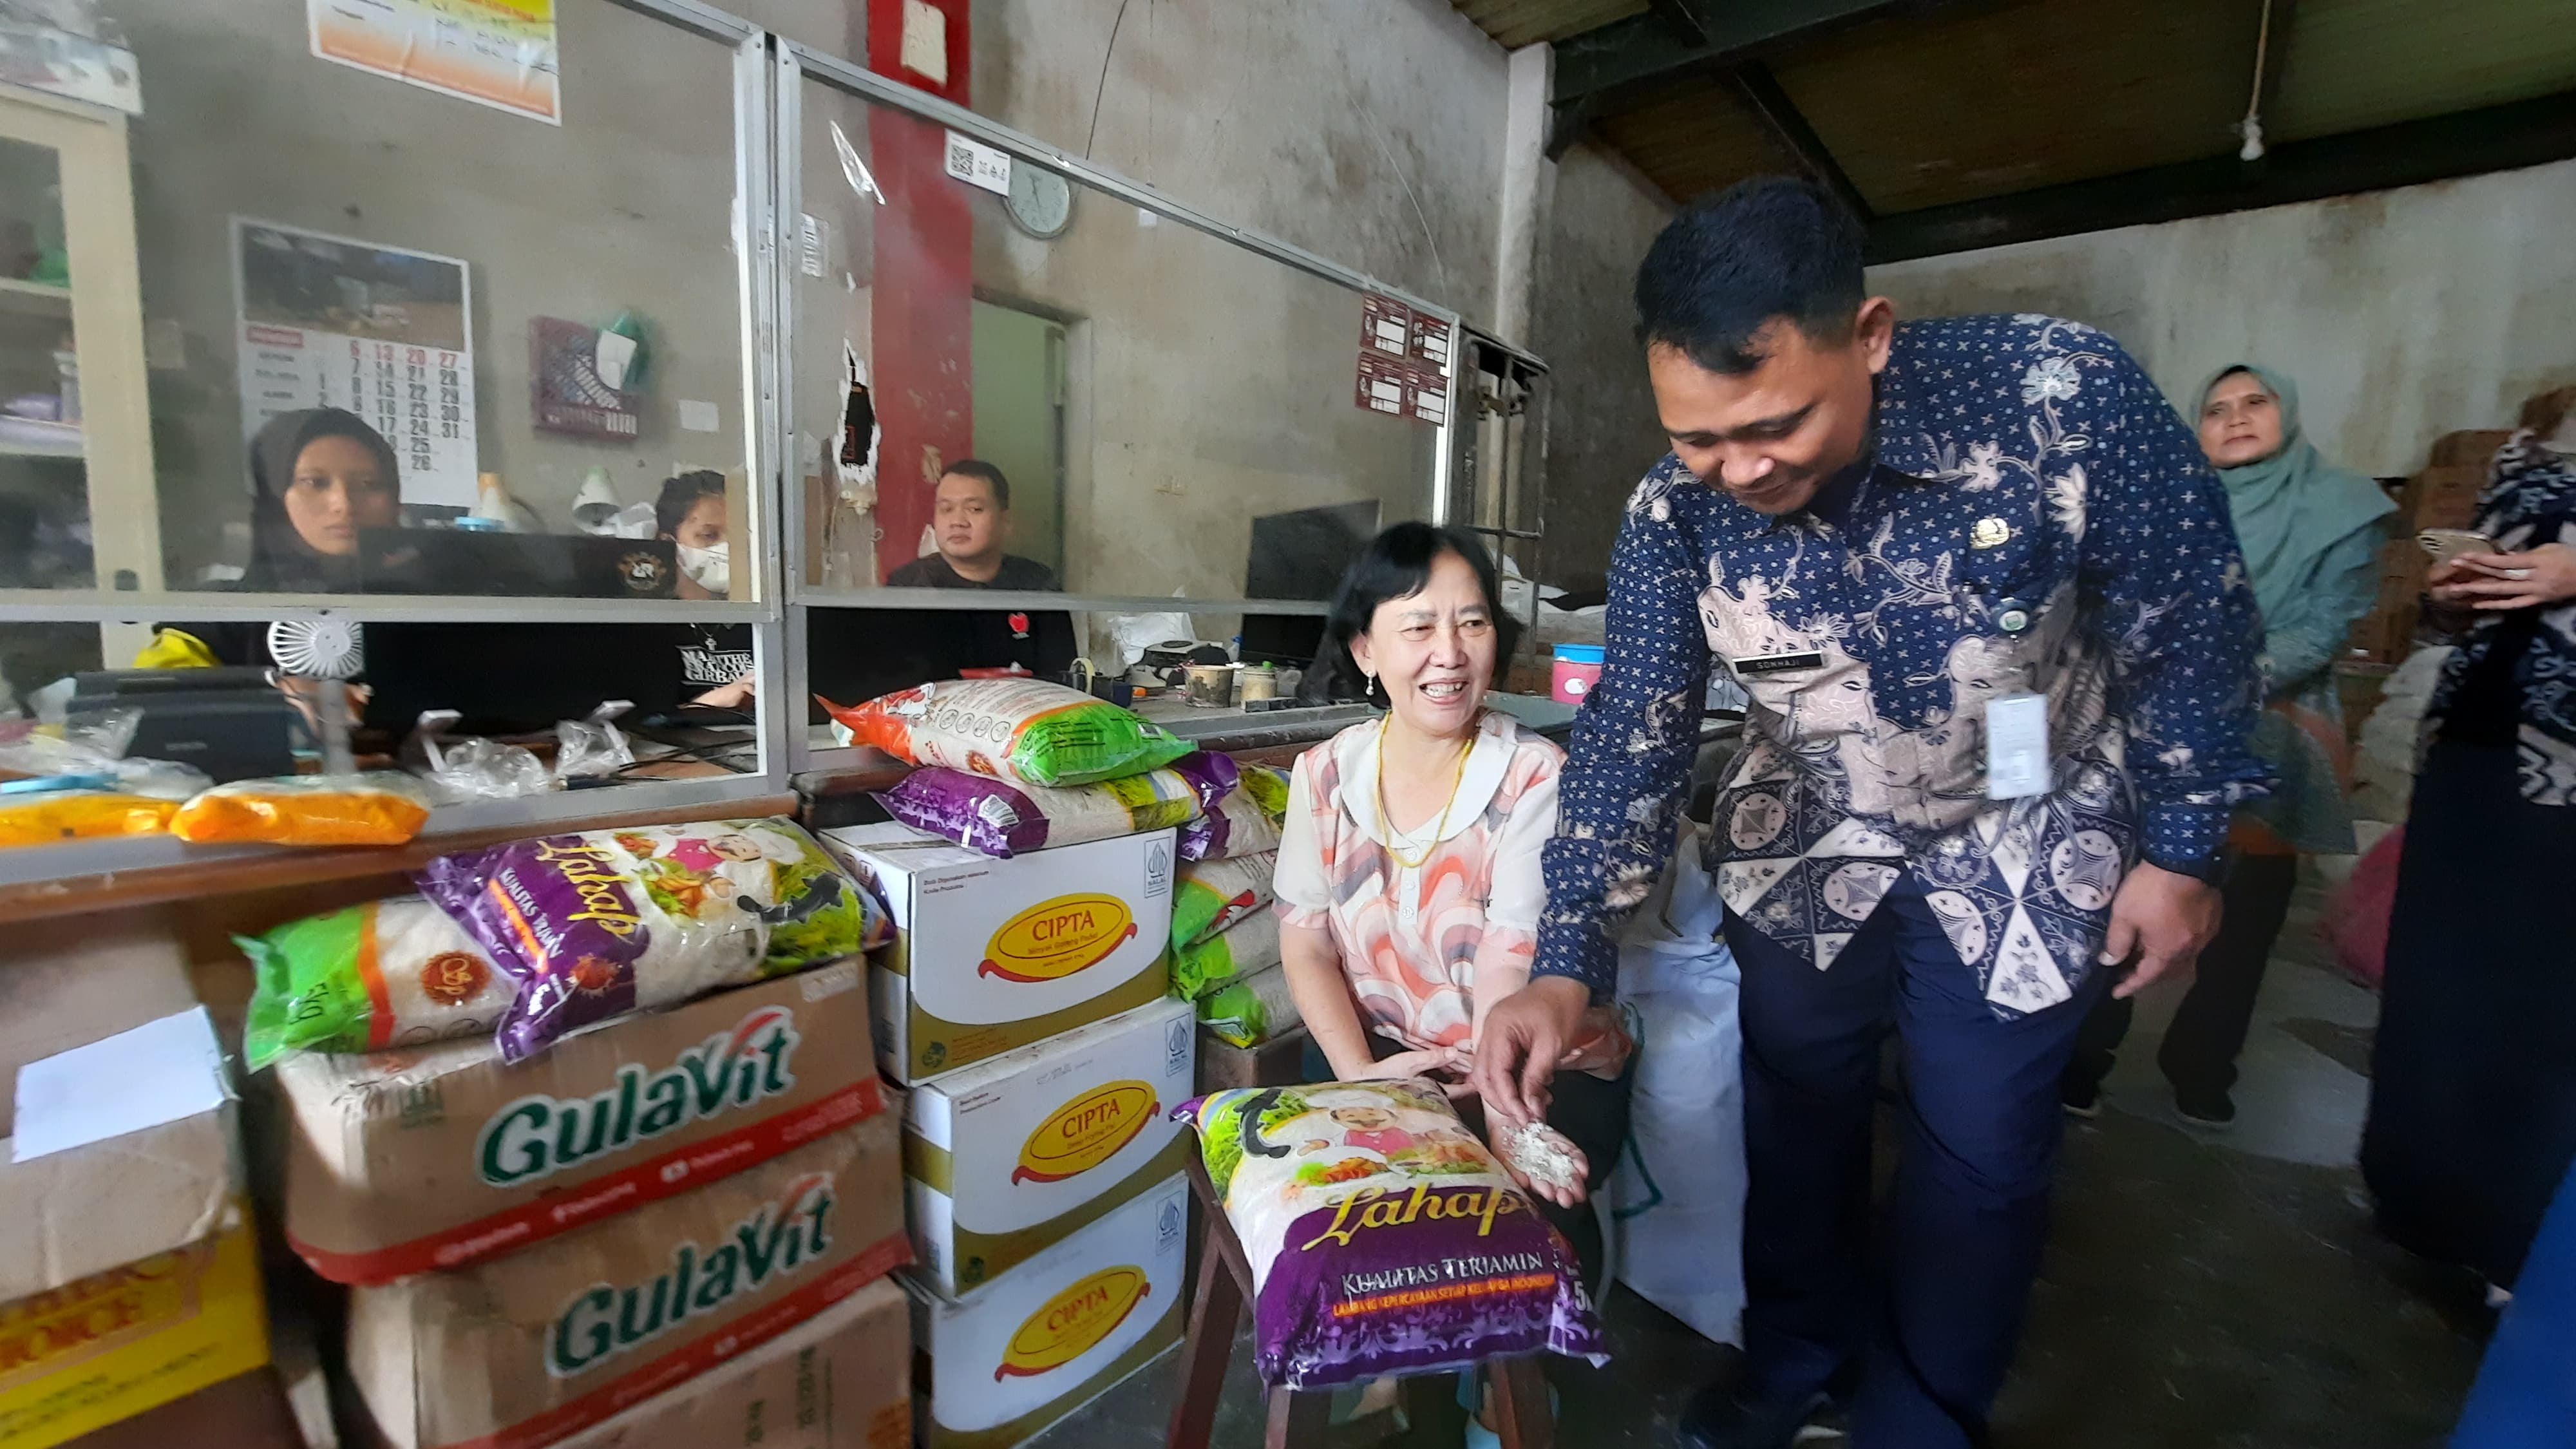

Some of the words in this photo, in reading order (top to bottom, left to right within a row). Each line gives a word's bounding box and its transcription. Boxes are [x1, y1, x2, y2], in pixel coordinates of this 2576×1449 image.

[407, 347, 426, 365] 20
[439, 350, 458, 369] 27
[408, 365, 425, 382] 21
[439, 369, 459, 386] 28
[377, 380, 395, 397] 15
[409, 384, 427, 401] 22
[439, 388, 459, 405] 29
[377, 398, 395, 416] 16
[410, 402, 429, 419] 23
[440, 405, 460, 422] 30
[378, 417, 397, 432] 17
[410, 420, 429, 436] 24
[442, 423, 460, 439] 31
[411, 437, 430, 453] 25
[412, 455, 431, 471] 26
[498, 867, 539, 917] KUALITAS
[535, 840, 641, 945] Lahap
[1032, 909, 1095, 942] CIPTA
[480, 1010, 793, 1184] GulaVit
[1063, 1098, 1121, 1139] CIPTA
[1301, 1182, 1534, 1251] Lahap
[555, 1173, 832, 1371] GulaVit
[1341, 1263, 1439, 1296] KUALITAS
[1441, 1251, 1544, 1280] TERJAMIN
[1048, 1285, 1109, 1331] CIPTA
